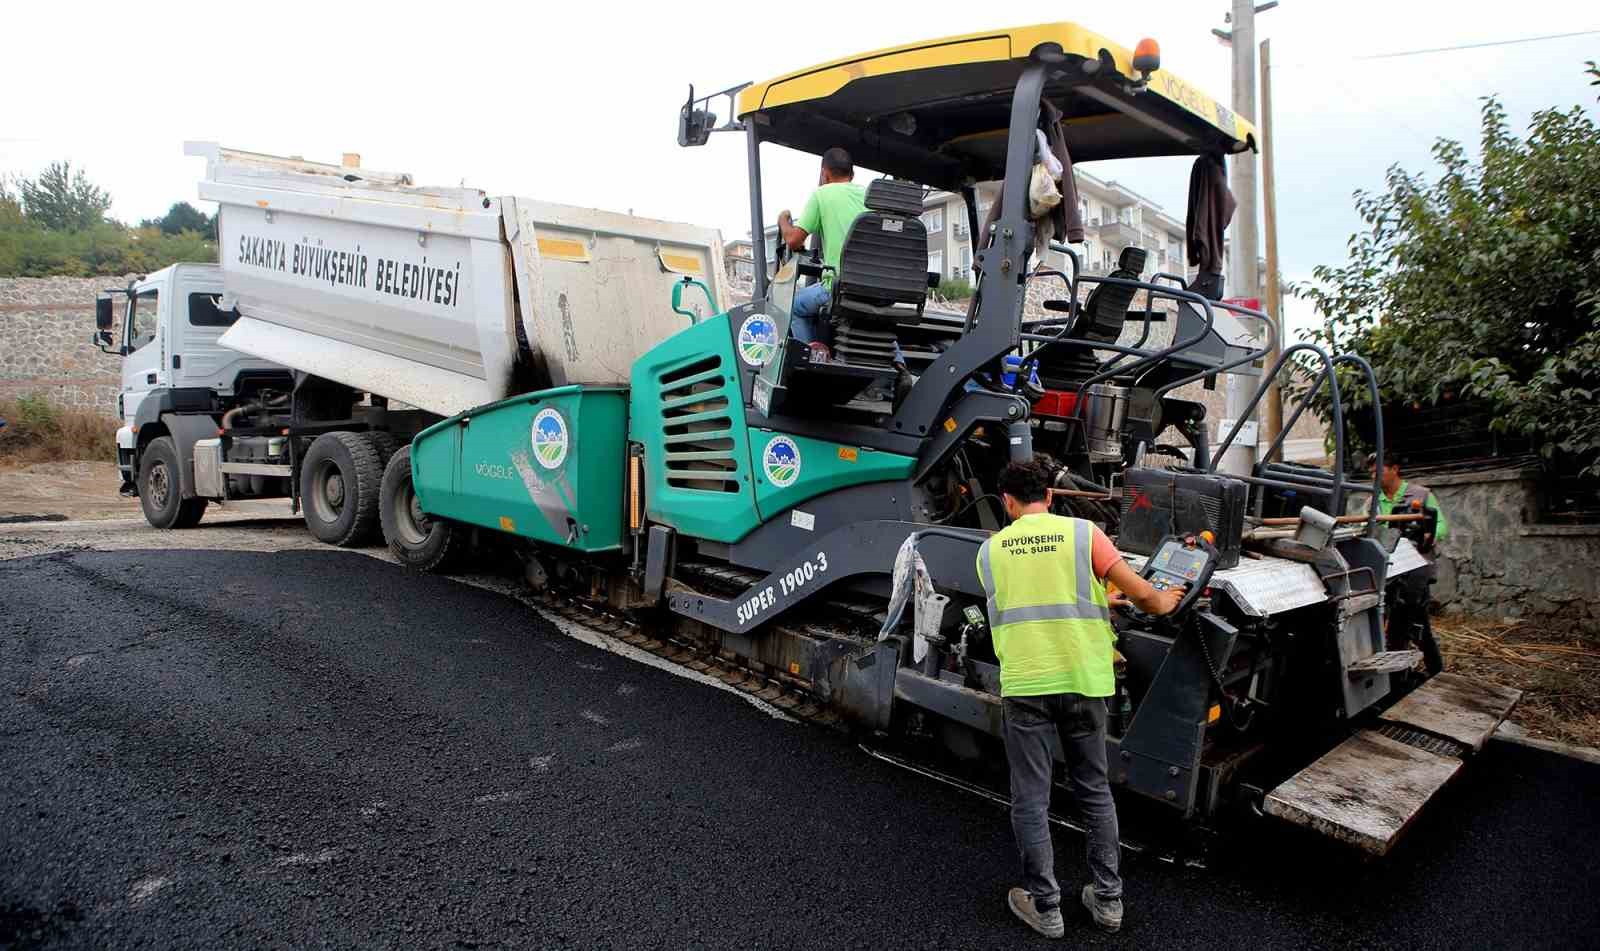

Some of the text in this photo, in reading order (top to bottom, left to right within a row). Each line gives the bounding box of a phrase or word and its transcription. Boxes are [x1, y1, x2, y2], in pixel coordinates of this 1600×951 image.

[238, 234, 461, 307] SAKARYA BÜYÜKŞEHİR BELEDİYESİ
[736, 551, 828, 625] SUPER 1900-3
[1009, 547, 1028, 556] YOL
